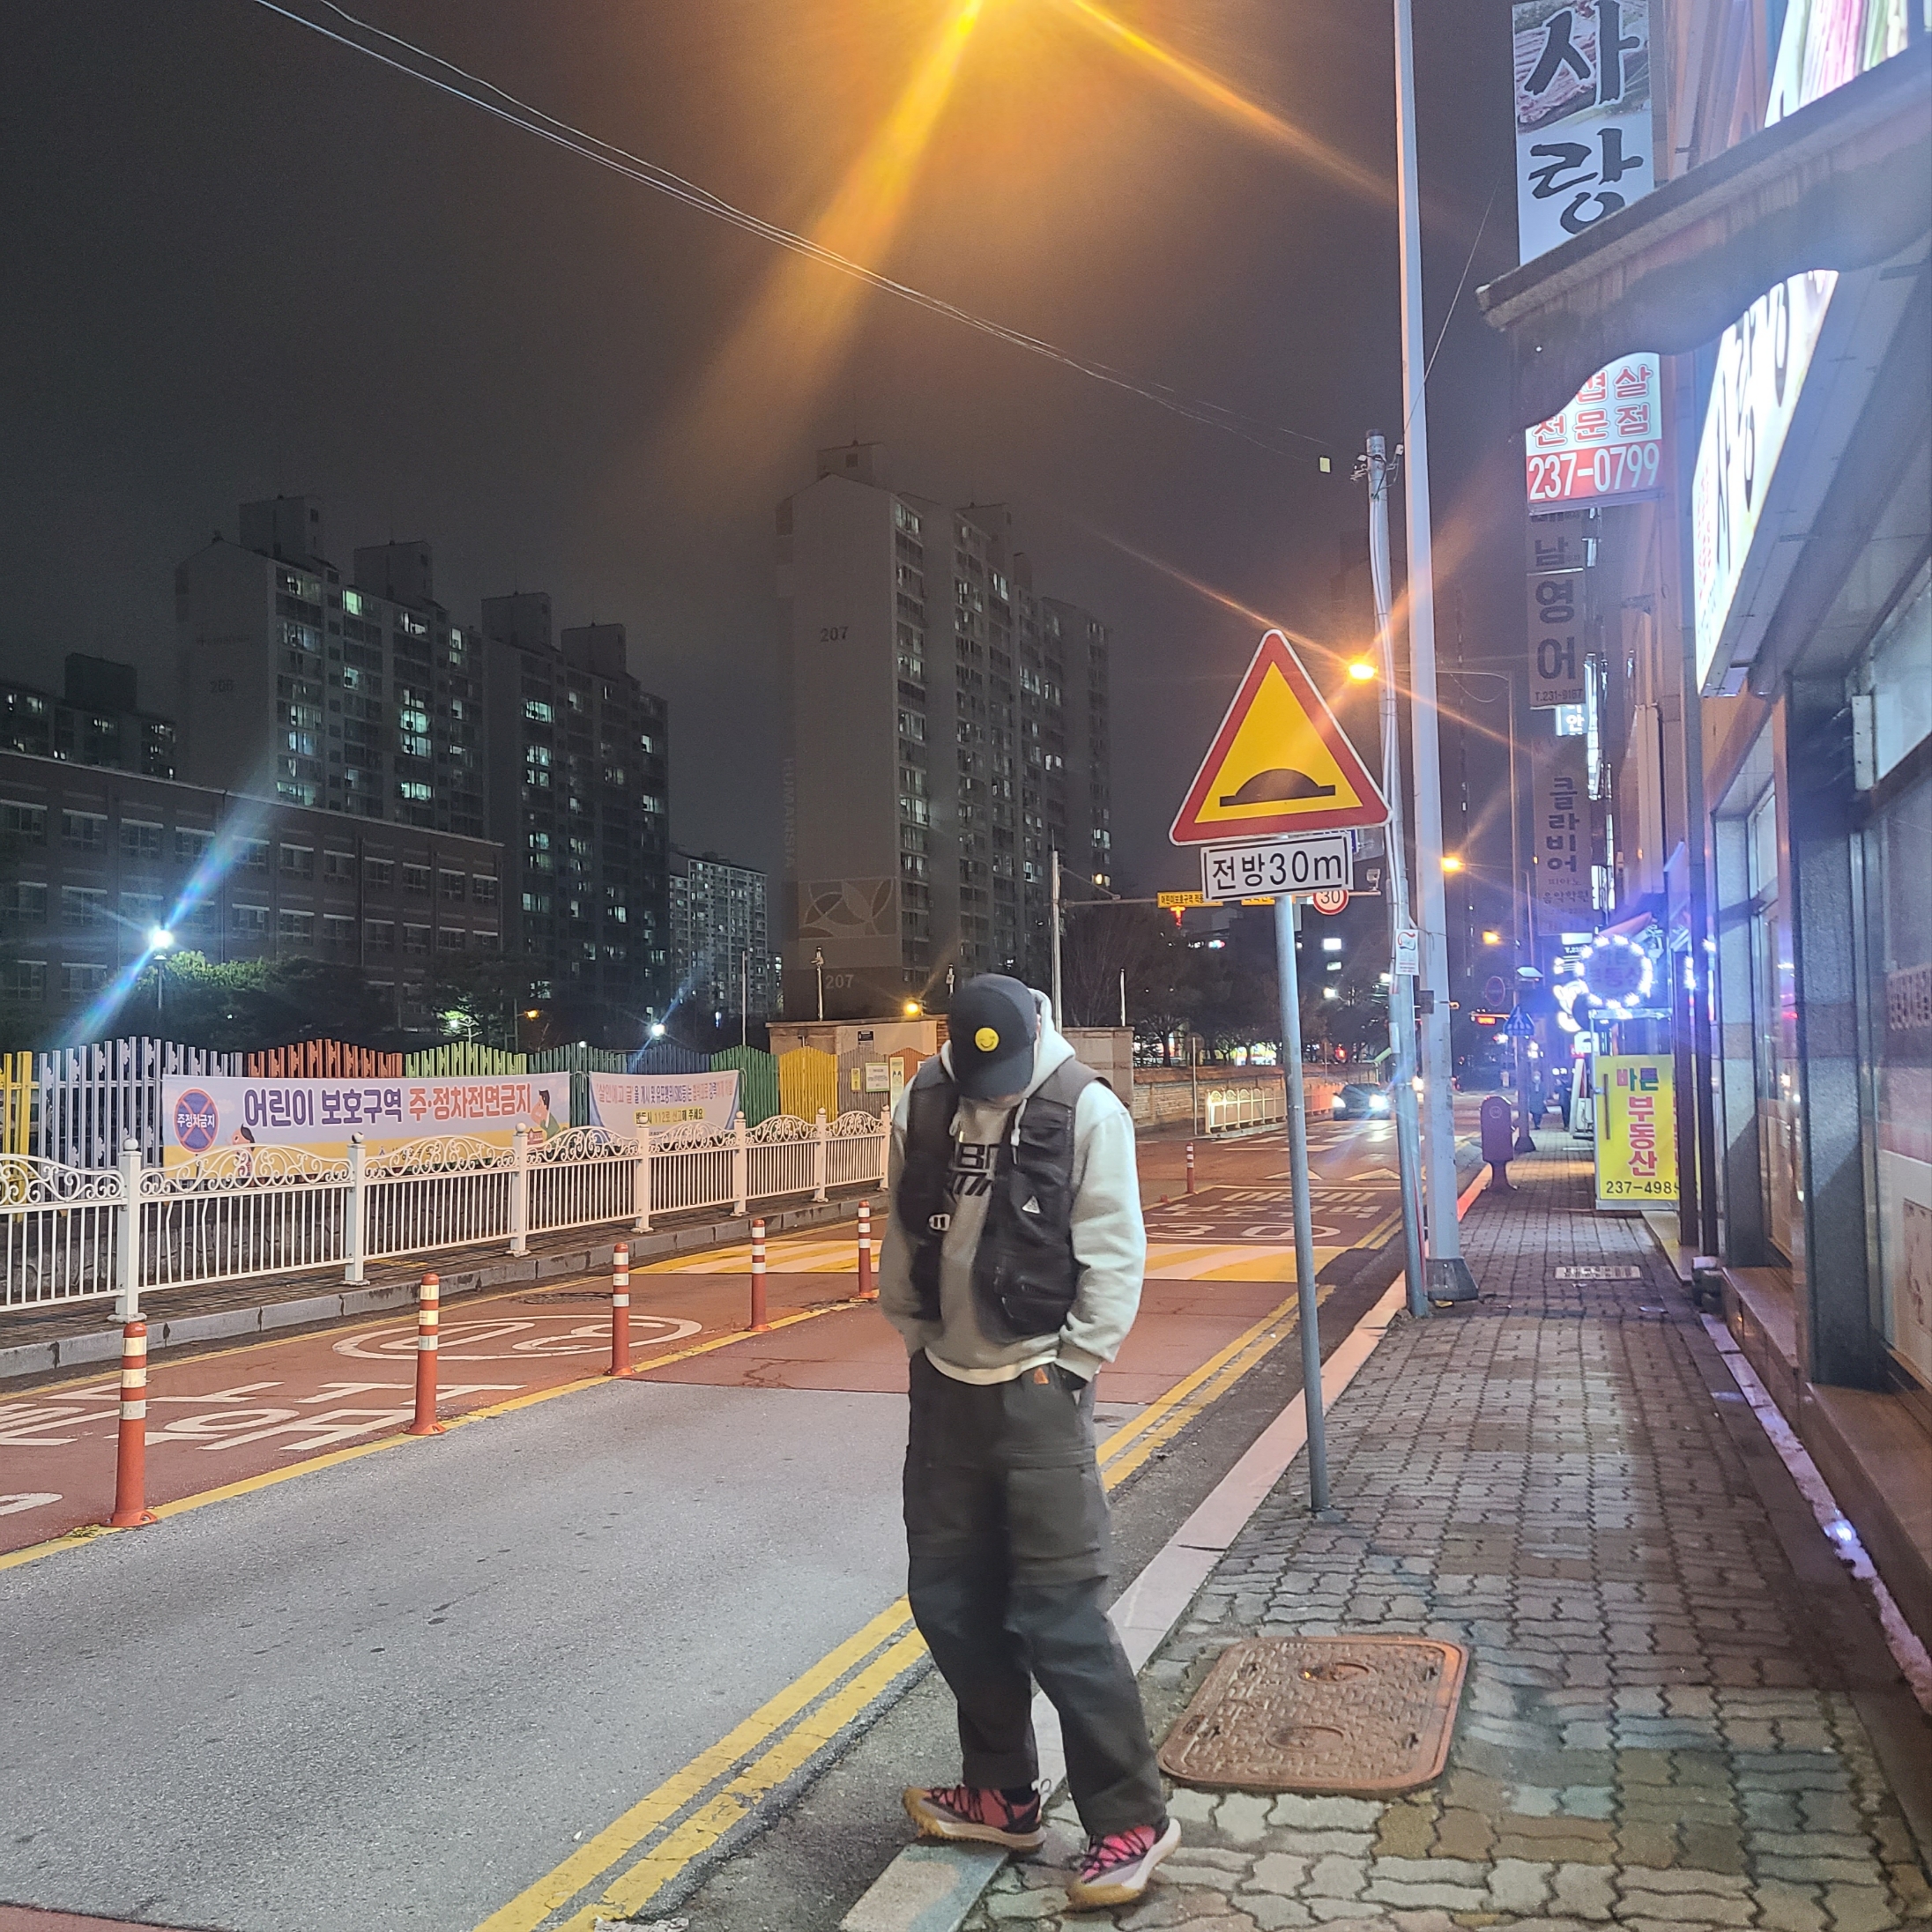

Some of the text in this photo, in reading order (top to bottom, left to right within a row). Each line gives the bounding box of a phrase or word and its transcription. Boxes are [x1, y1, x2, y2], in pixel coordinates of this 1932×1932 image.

[1524, 0, 1645, 234] 사랑
[1533, 404, 1647, 446] 전문점
[1529, 442, 1660, 500] 237-0799
[821, 627, 849, 642] 207
[1212, 850, 1342, 890] 전방30m
[1320, 891, 1341, 904] 30
[825, 974, 854, 989] 207
[1616, 1067, 1660, 1092] 바른
[176, 1113, 215, 1129] 주정차금지
[244, 1089, 314, 1127] 어린이
[321, 1088, 402, 1125] 보호구역
[1627, 1096, 1659, 1177] 부동산
